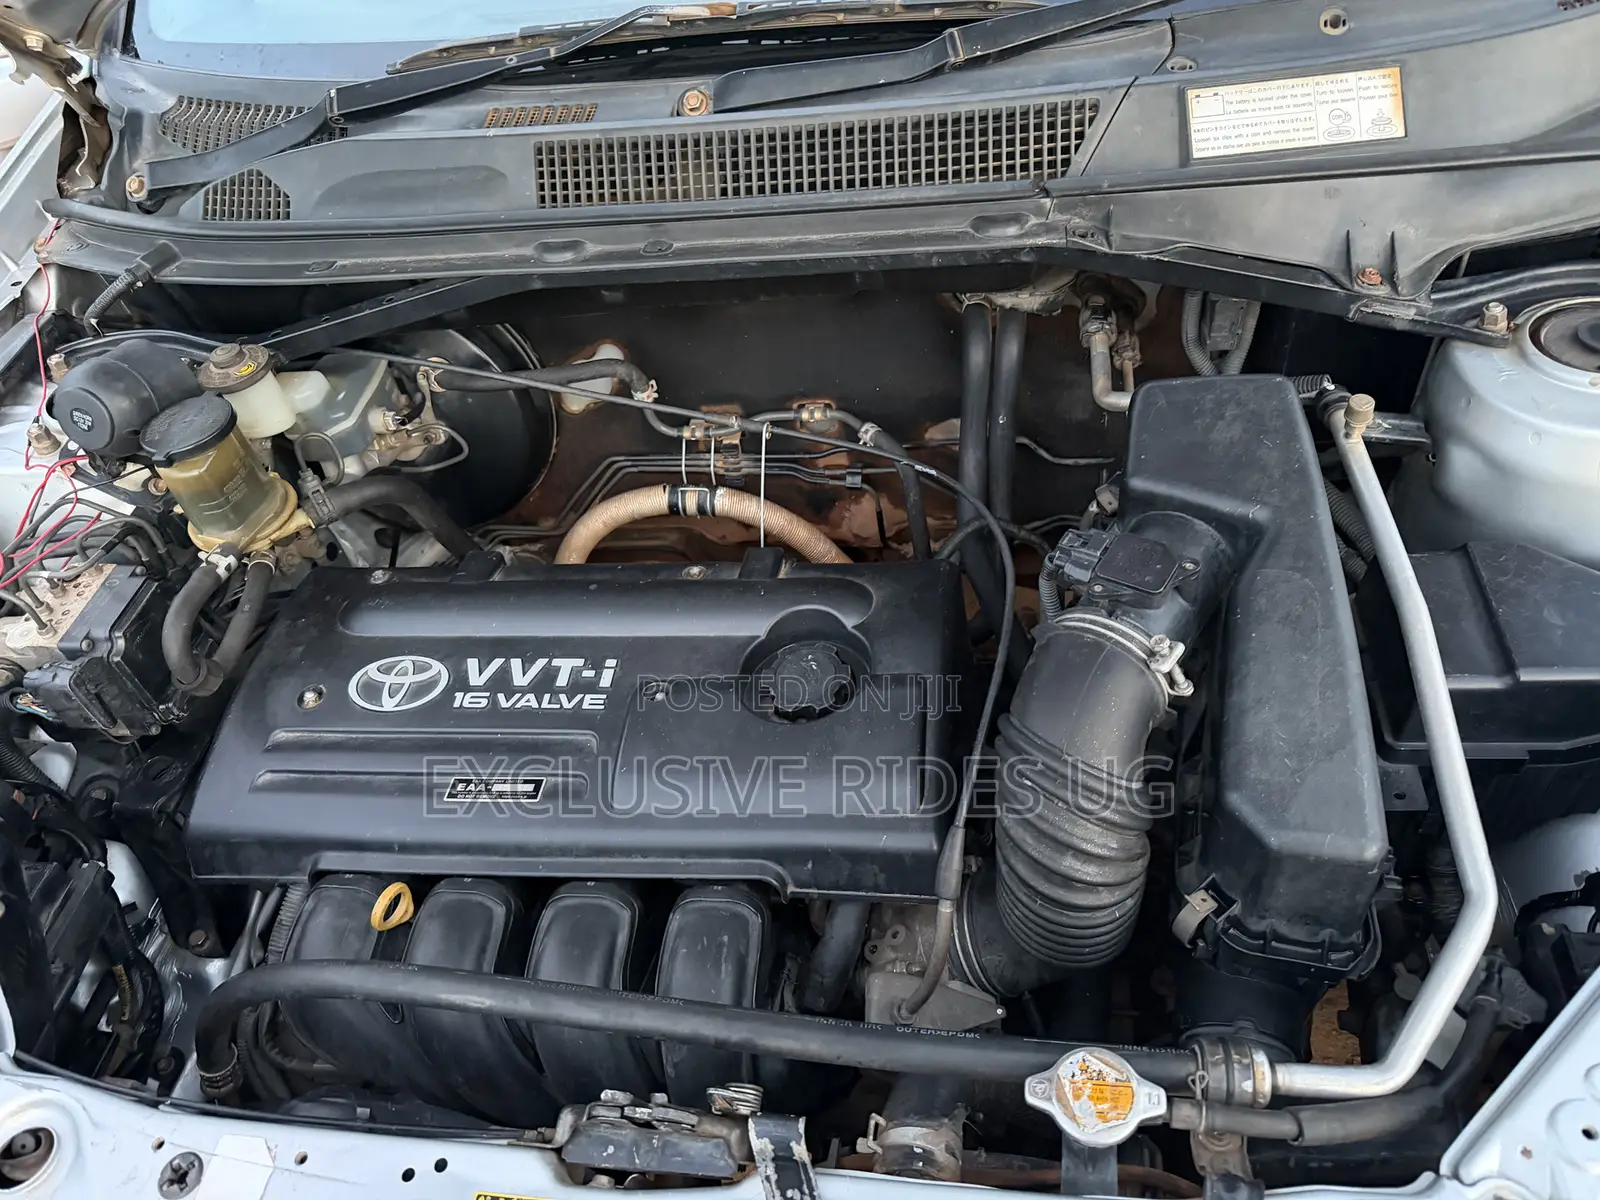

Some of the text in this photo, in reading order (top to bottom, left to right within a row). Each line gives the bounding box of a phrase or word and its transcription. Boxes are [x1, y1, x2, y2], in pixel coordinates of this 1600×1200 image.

[466, 657, 619, 688] VVT-i
[453, 692, 607, 710] 16 VALVE
